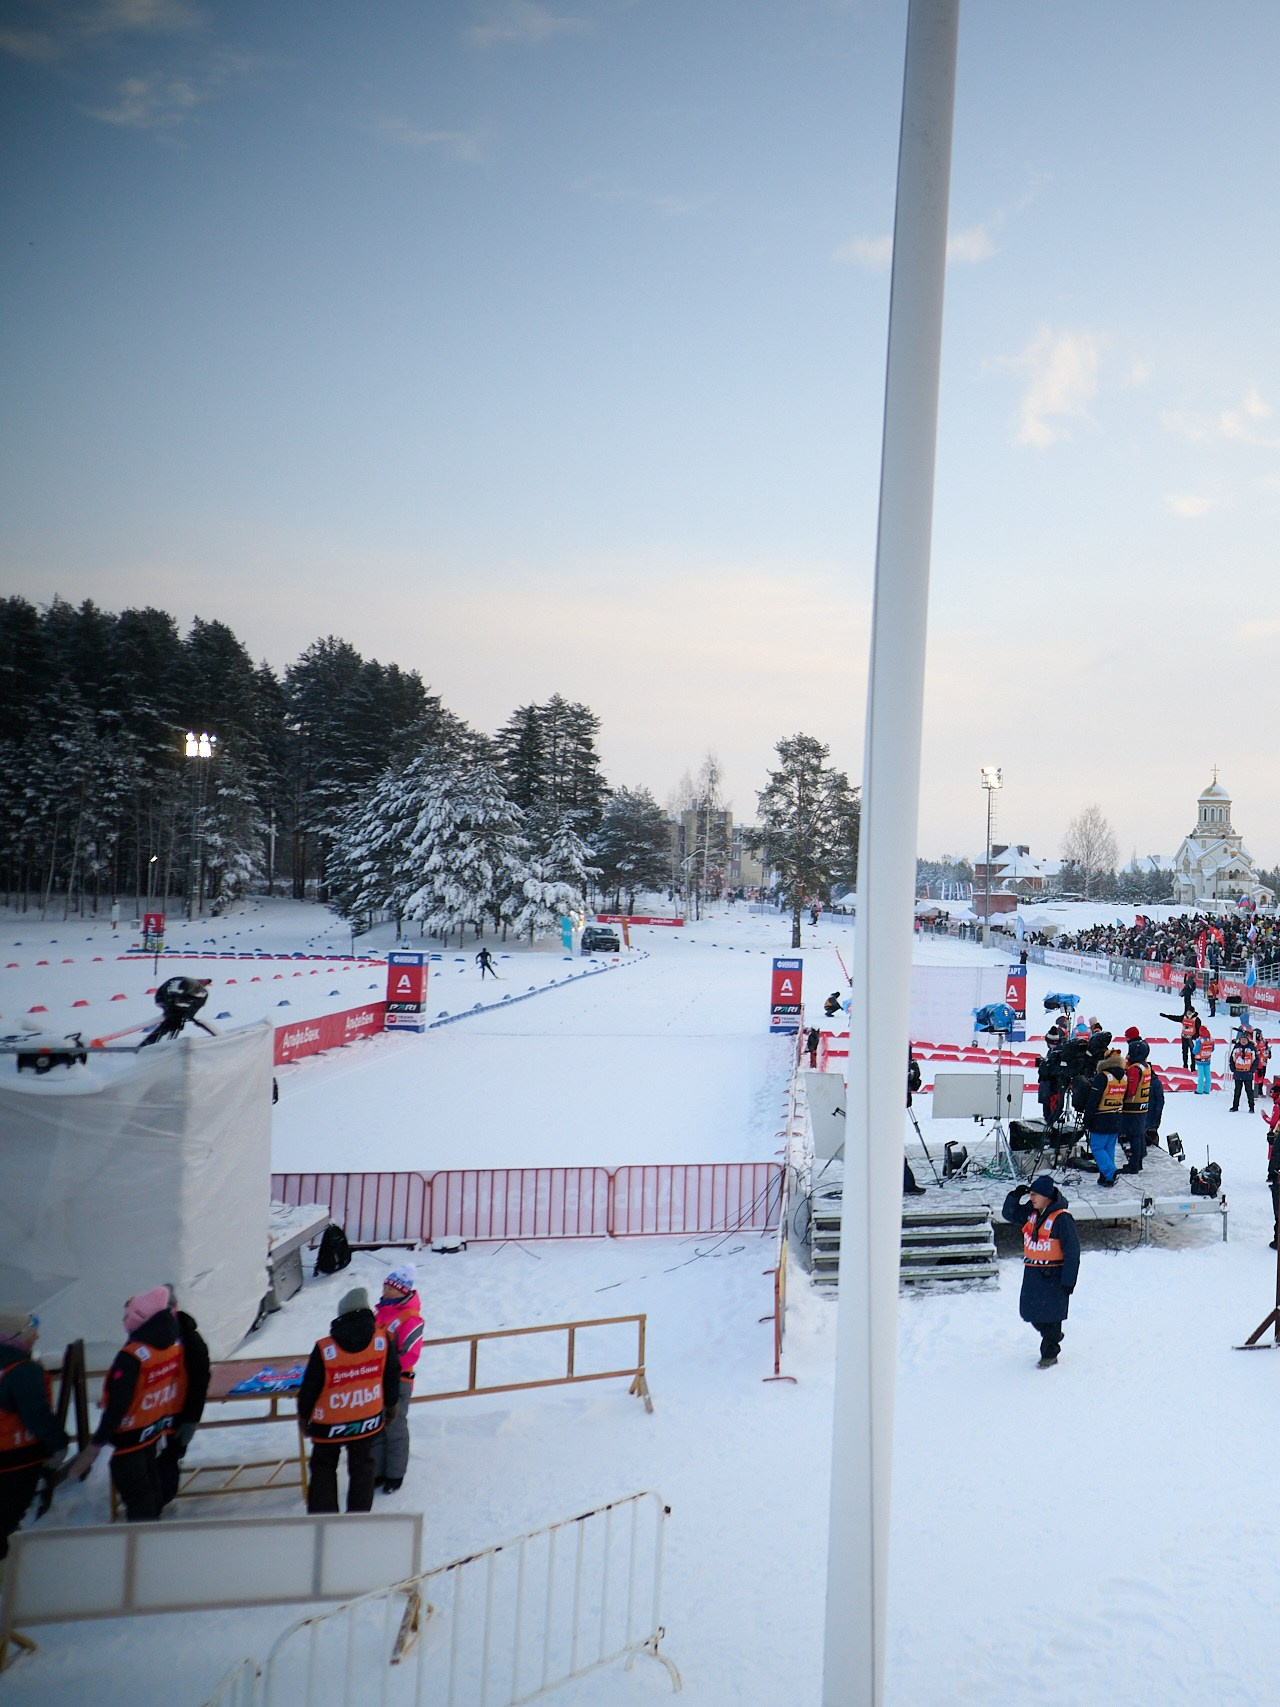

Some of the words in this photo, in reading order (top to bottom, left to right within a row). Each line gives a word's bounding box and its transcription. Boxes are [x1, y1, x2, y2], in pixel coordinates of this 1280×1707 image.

[333, 1368, 360, 1382] Альфа
[360, 1365, 379, 1375] Банк
[330, 1384, 382, 1410] СУДЬЯ
[328, 1415, 381, 1438] PARI
